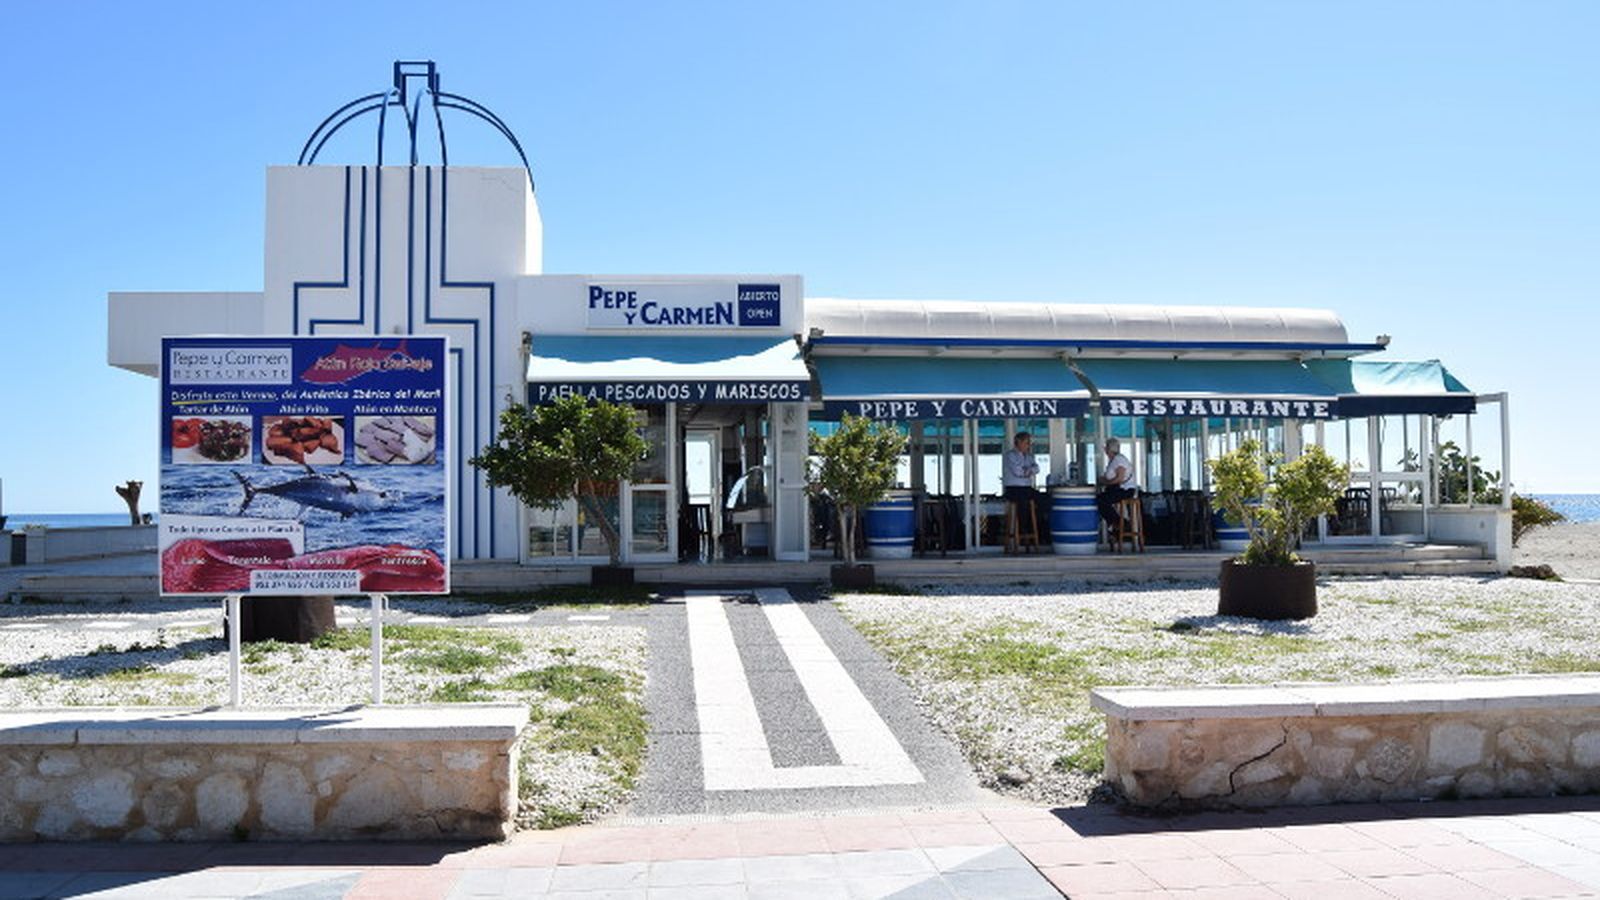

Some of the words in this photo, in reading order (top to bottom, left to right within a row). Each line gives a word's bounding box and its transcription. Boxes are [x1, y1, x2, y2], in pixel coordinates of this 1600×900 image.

[588, 286, 637, 309] PEPE
[739, 291, 779, 300] ABIERTO
[625, 313, 636, 325] Y
[641, 302, 734, 325] CARMEN
[747, 309, 773, 318] OPEN
[174, 351, 208, 366] Pepe
[225, 350, 289, 366] Carmen
[173, 369, 289, 379] RESTAURANTE
[352, 388, 391, 399] Ibérico
[394, 388, 411, 399] del
[605, 384, 691, 400] PESCADOS
[698, 384, 707, 399] Y
[715, 383, 801, 400] MARISCOS
[208, 403, 223, 413] de
[224, 403, 250, 413] Atún
[279, 404, 305, 413] Atún
[305, 404, 329, 413] Frito
[353, 404, 379, 413] Atún
[379, 405, 394, 413] en
[394, 404, 437, 413] Manteca
[859, 401, 919, 418] PEPE
[931, 401, 948, 418] Y
[960, 399, 1059, 417] CARMEN
[1109, 399, 1330, 418] RESTAURANTE
